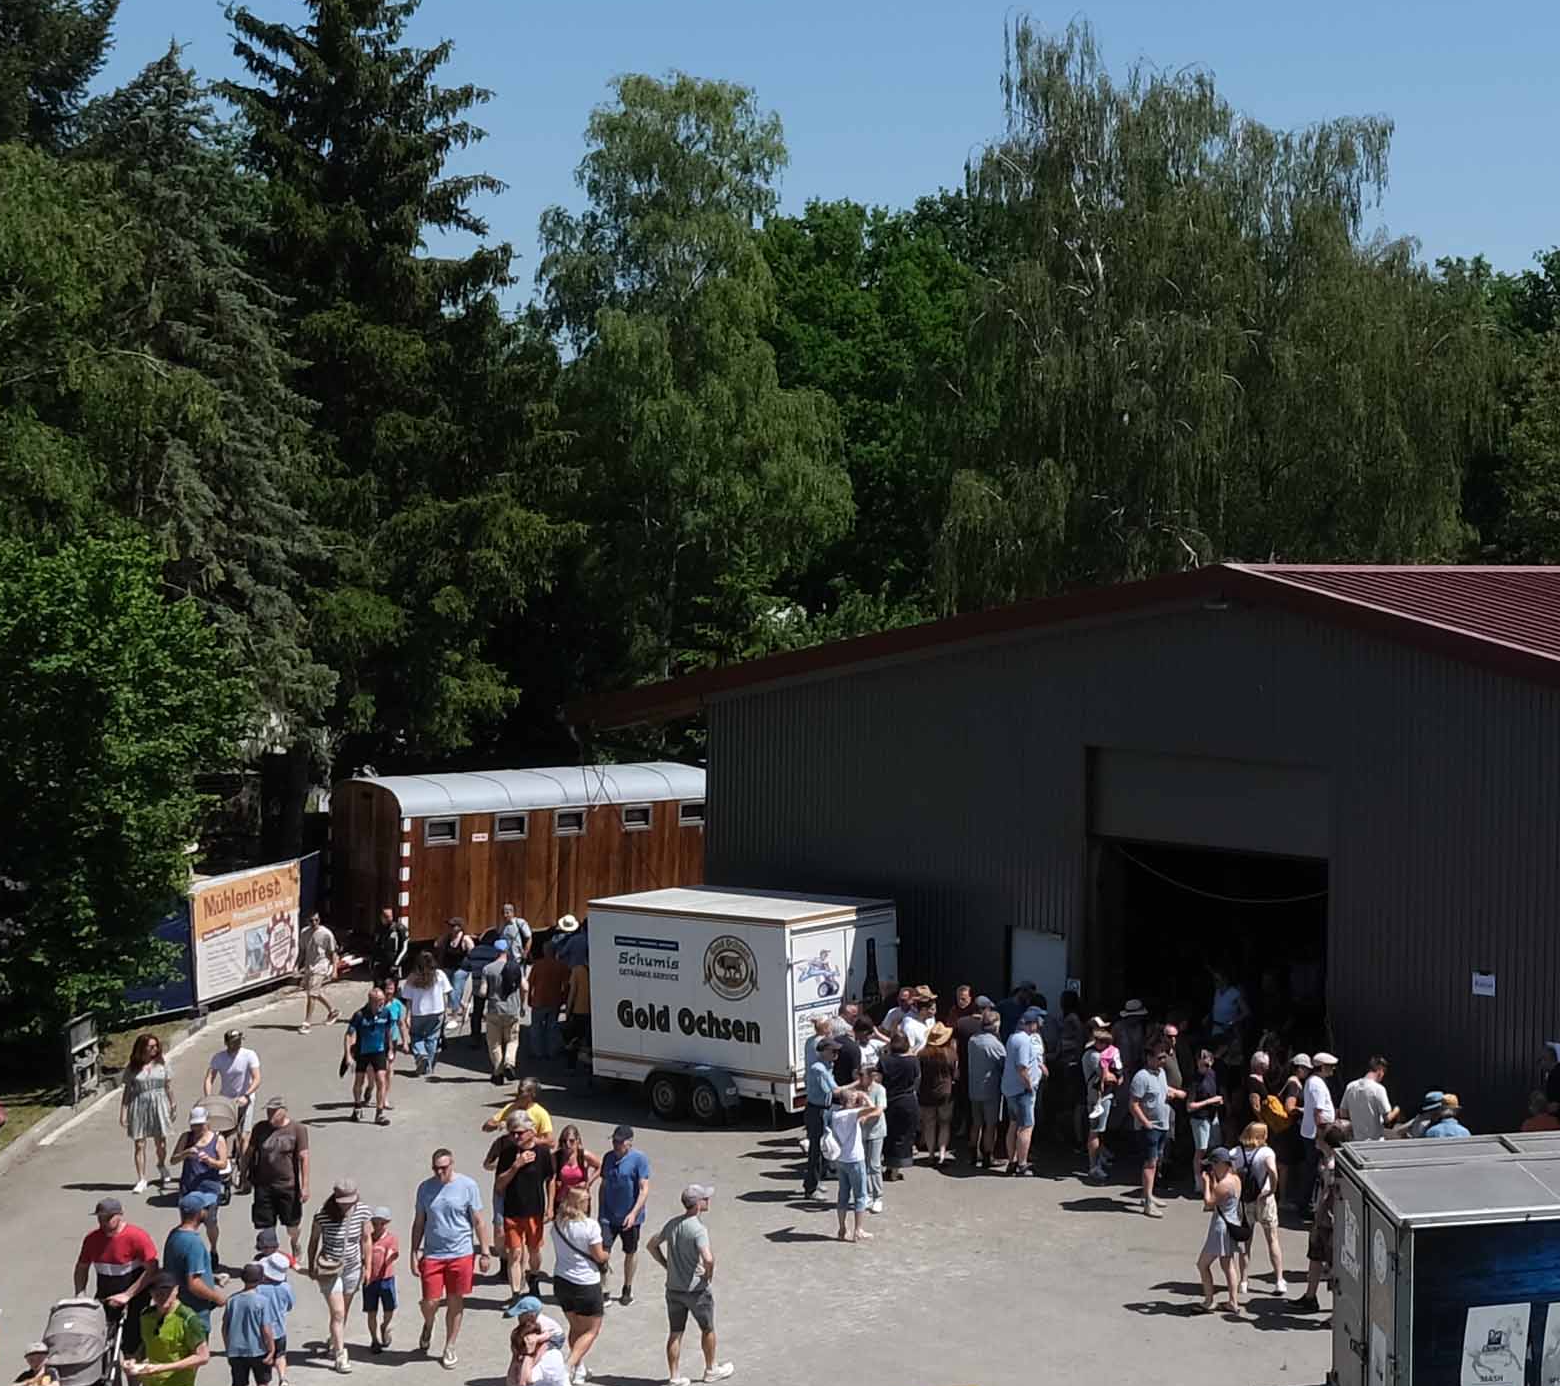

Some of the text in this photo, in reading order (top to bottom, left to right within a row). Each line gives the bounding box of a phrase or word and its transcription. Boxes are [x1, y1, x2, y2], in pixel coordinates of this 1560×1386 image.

[203, 876, 281, 920] Mühlenfest
[618, 951, 680, 970] Schumis
[616, 999, 671, 1033] Gold
[677, 1007, 761, 1045] Ochsen
